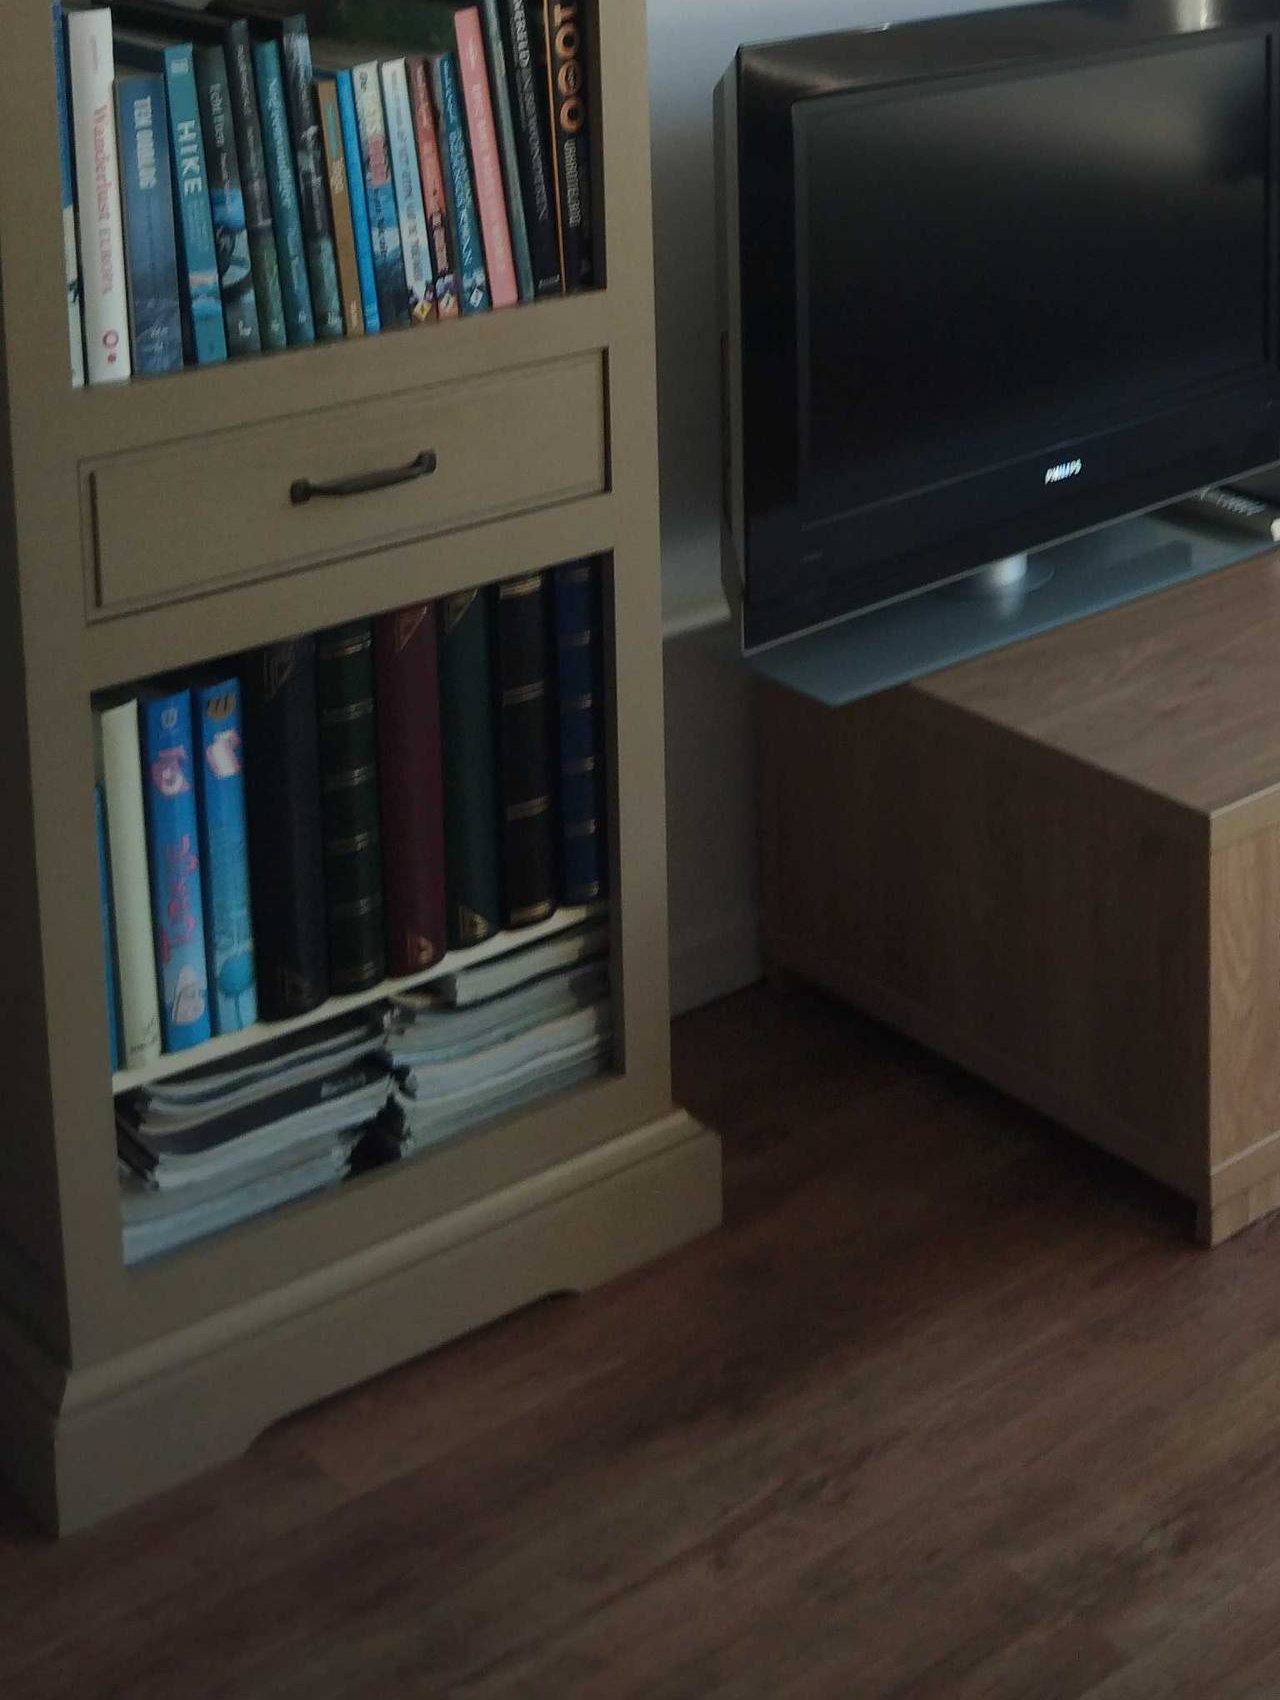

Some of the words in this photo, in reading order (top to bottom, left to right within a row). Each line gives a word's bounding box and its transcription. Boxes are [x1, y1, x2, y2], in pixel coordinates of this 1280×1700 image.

[90, 104, 114, 222] Wanderlust
[174, 118, 204, 197] HIKE
[1044, 458, 1082, 485] PHILIPS
